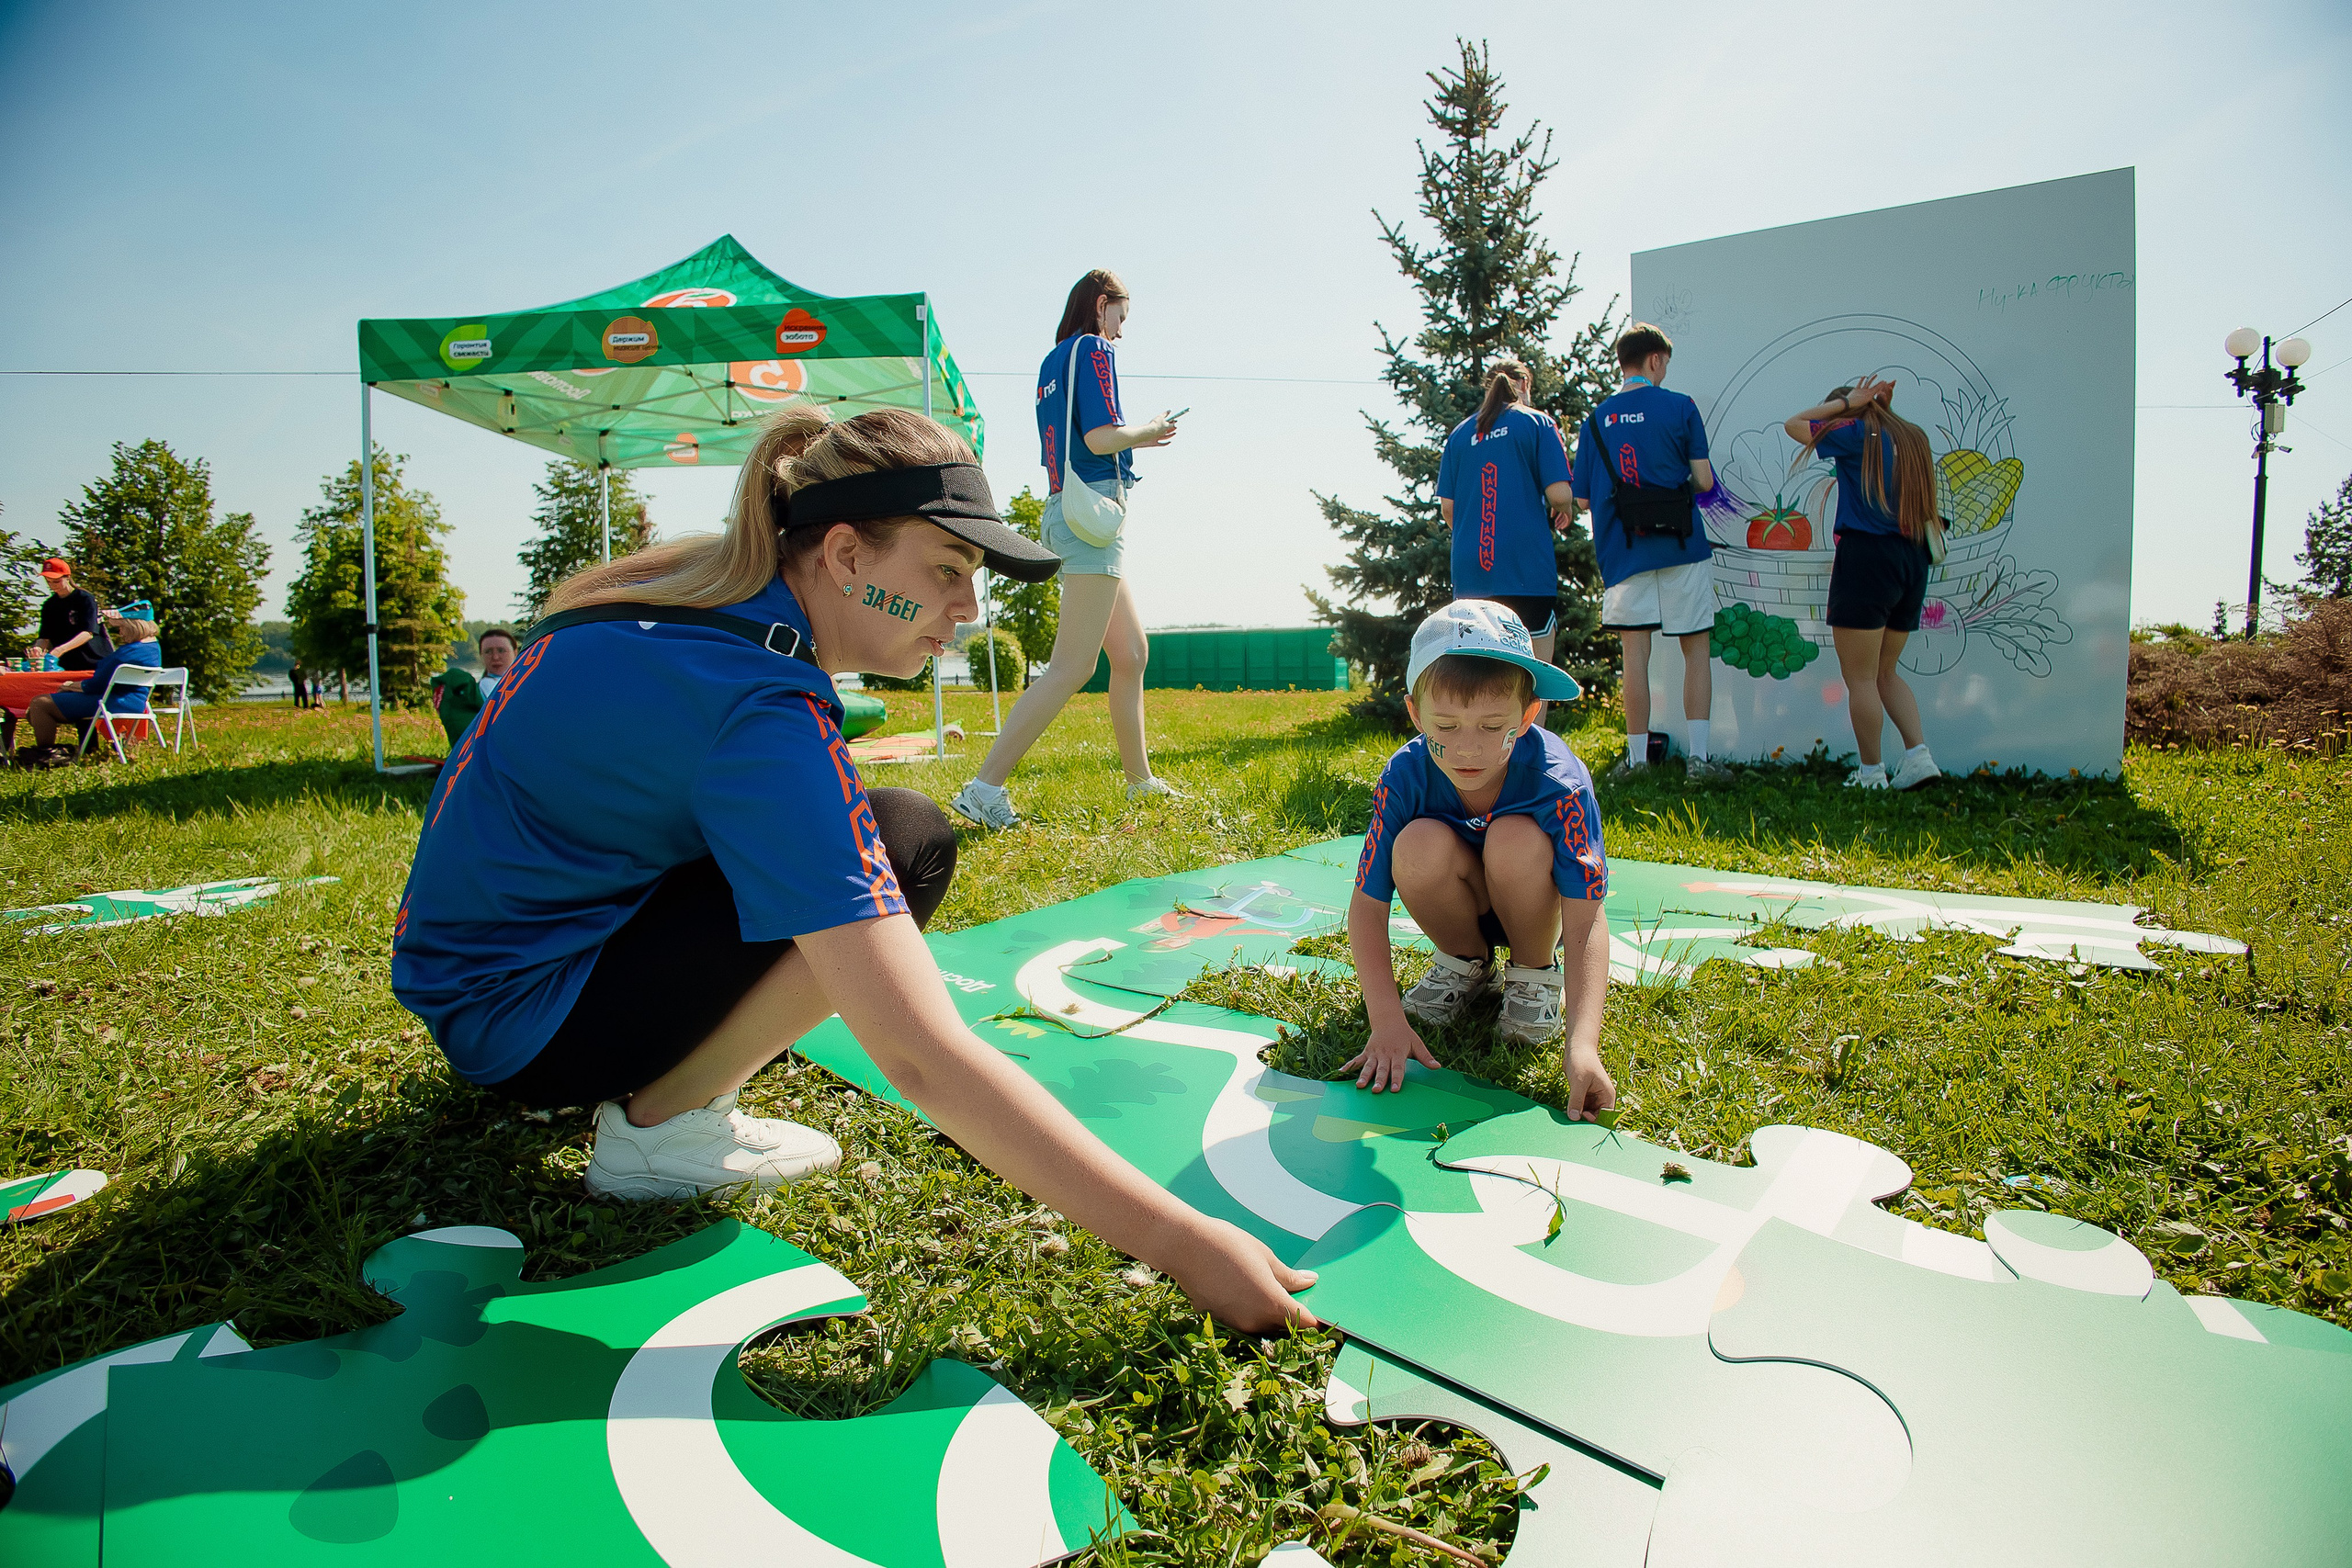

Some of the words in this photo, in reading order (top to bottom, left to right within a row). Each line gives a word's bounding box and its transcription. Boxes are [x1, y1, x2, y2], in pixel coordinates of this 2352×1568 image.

[612, 336, 645, 344] Держим
[785, 333, 814, 341] забота
[1044, 378, 1057, 399] ПСБ
[1620, 412, 1645, 423] ПСБ
